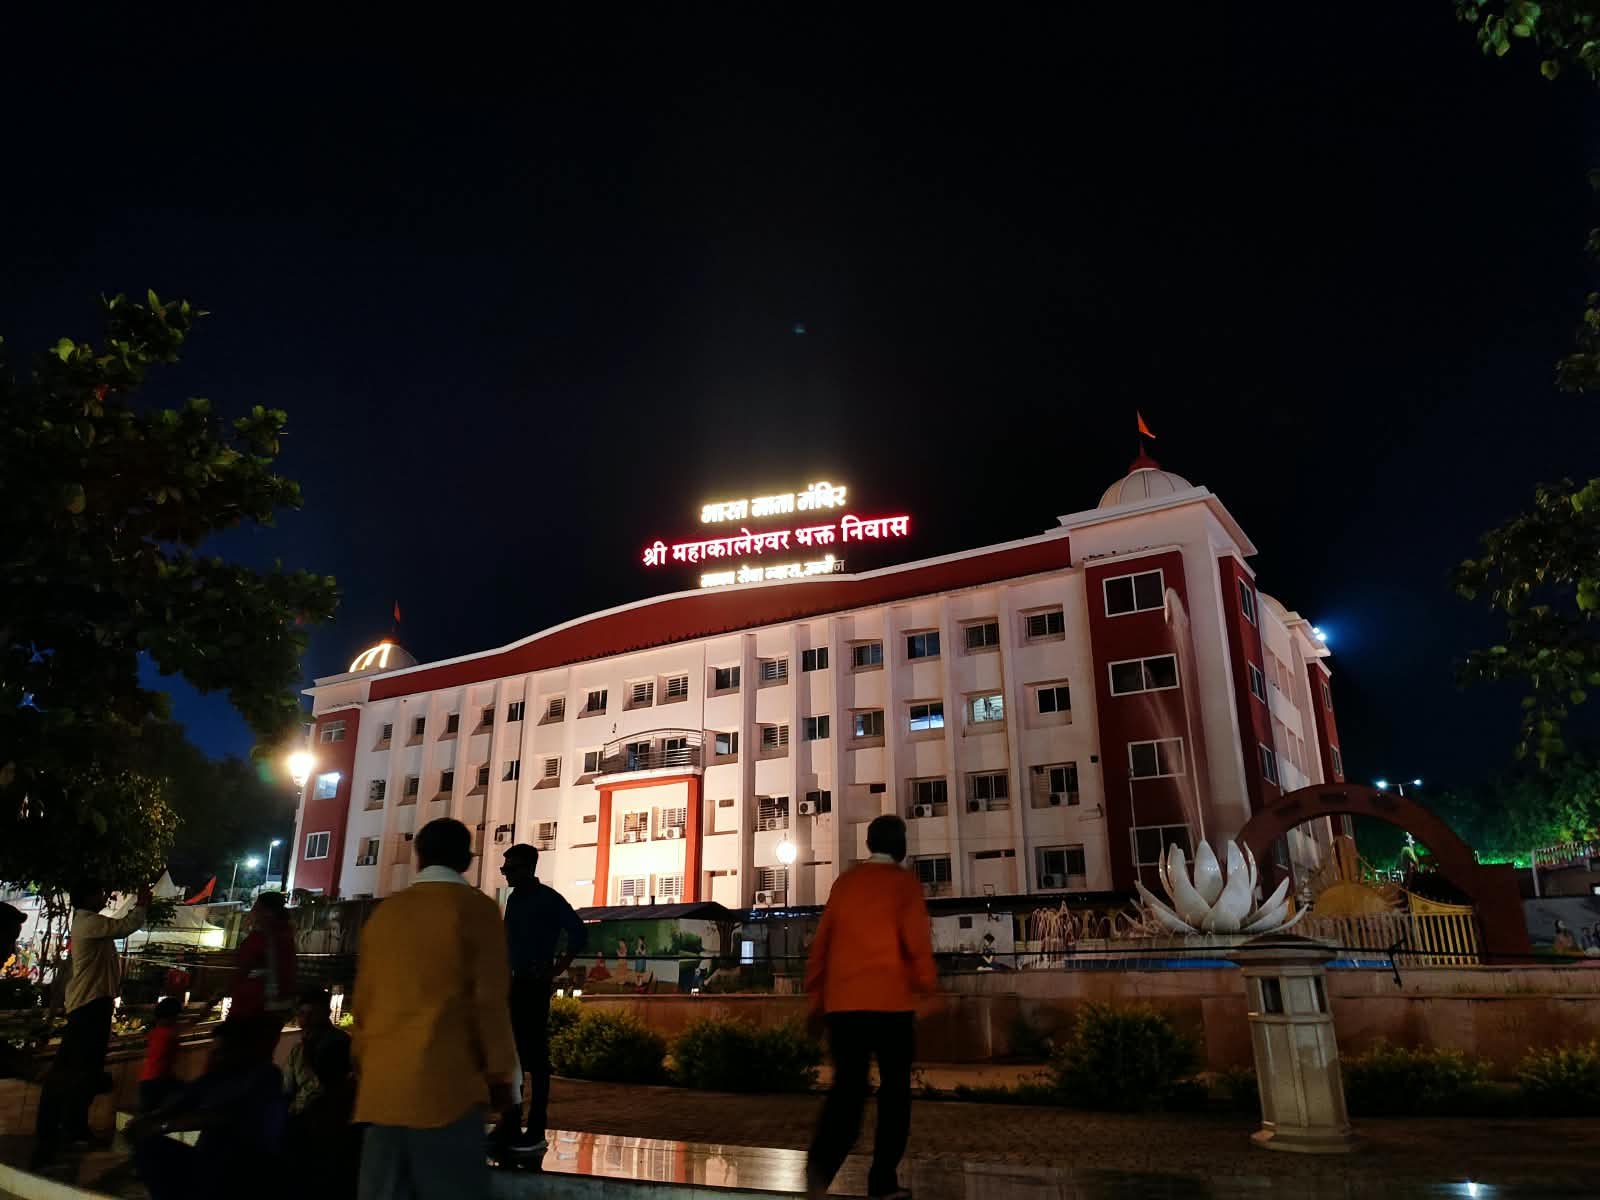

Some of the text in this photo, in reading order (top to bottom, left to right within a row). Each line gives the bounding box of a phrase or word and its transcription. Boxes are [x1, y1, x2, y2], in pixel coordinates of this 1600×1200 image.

[642, 514, 909, 567] श्री महाकालेश्वर भक्त निवास
